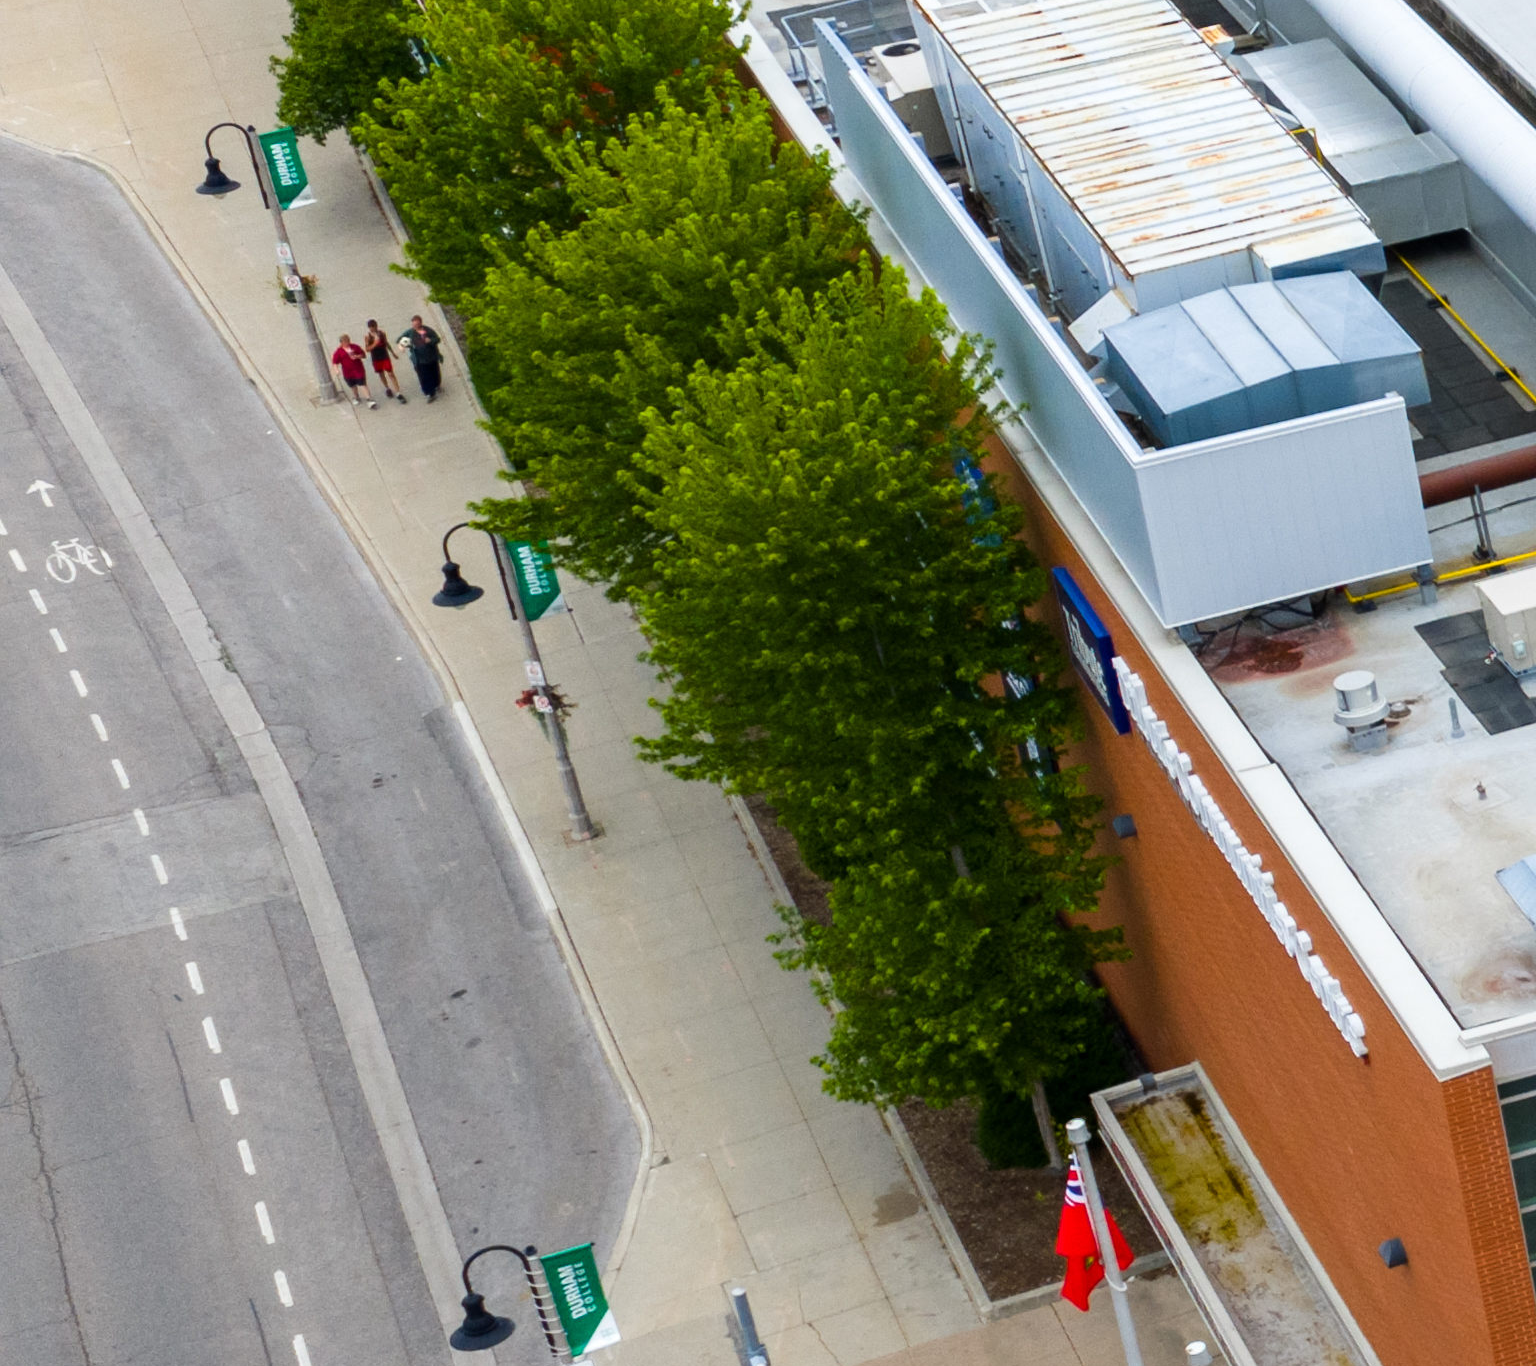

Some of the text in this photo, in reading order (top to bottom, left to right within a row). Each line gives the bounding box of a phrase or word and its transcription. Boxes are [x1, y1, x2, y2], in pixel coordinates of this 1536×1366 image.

[270, 143, 293, 186] DURHAM
[517, 545, 543, 596] DURHAM
[557, 1264, 588, 1320] DURHAM
[574, 1261, 597, 1313] COLLEGE
